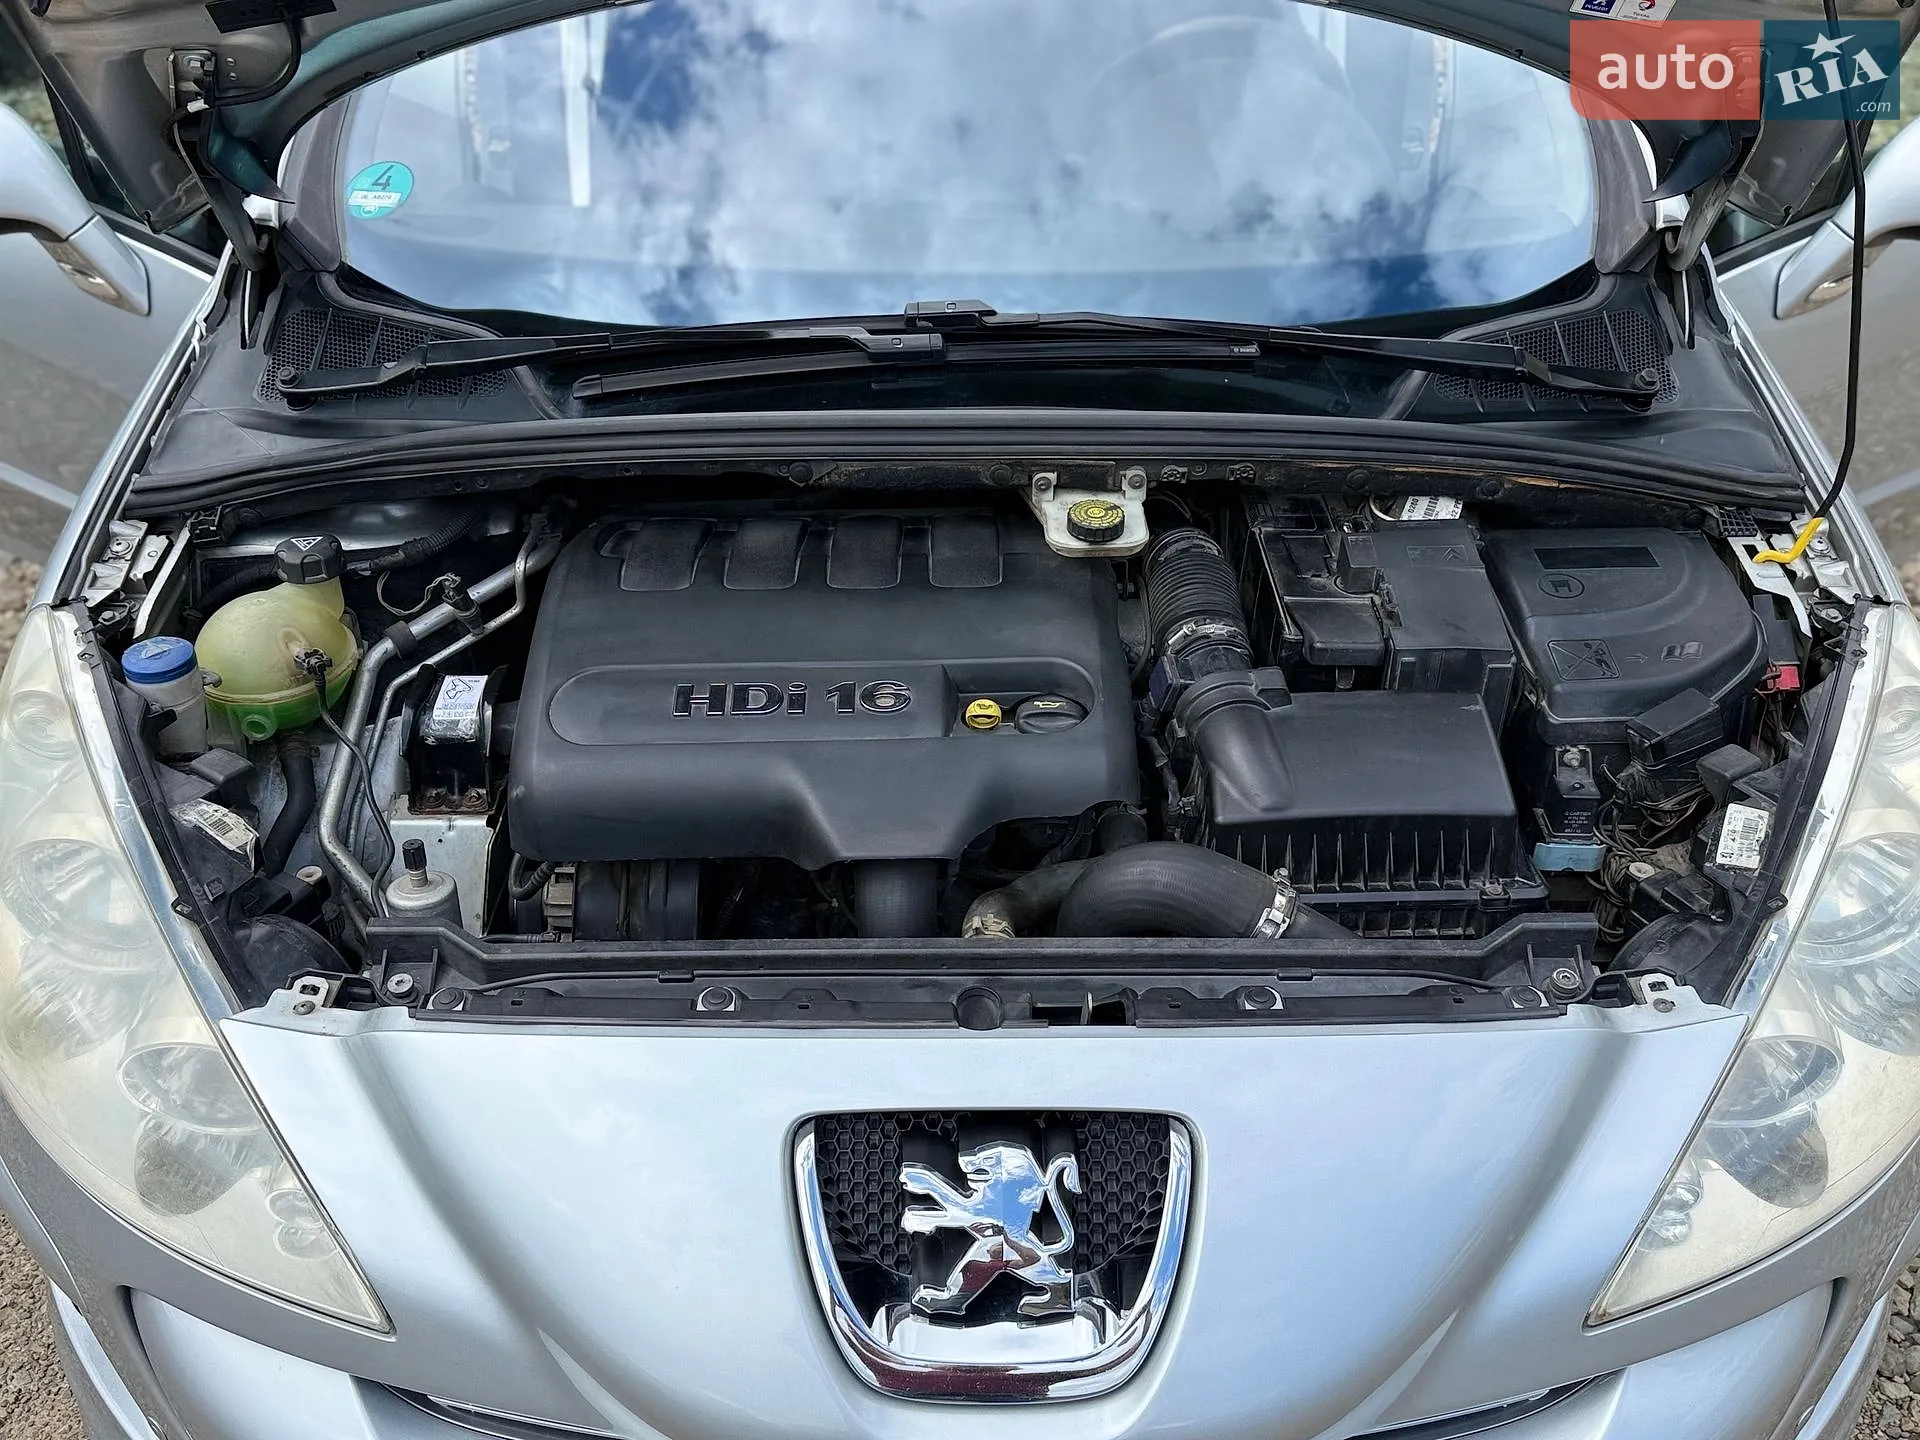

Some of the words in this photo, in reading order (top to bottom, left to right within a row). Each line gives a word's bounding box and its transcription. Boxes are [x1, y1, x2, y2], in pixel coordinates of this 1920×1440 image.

[1584, 4, 1608, 12] PEUGEOT
[372, 164, 395, 190] 4
[673, 681, 807, 717] HDi
[825, 680, 911, 714] 16
